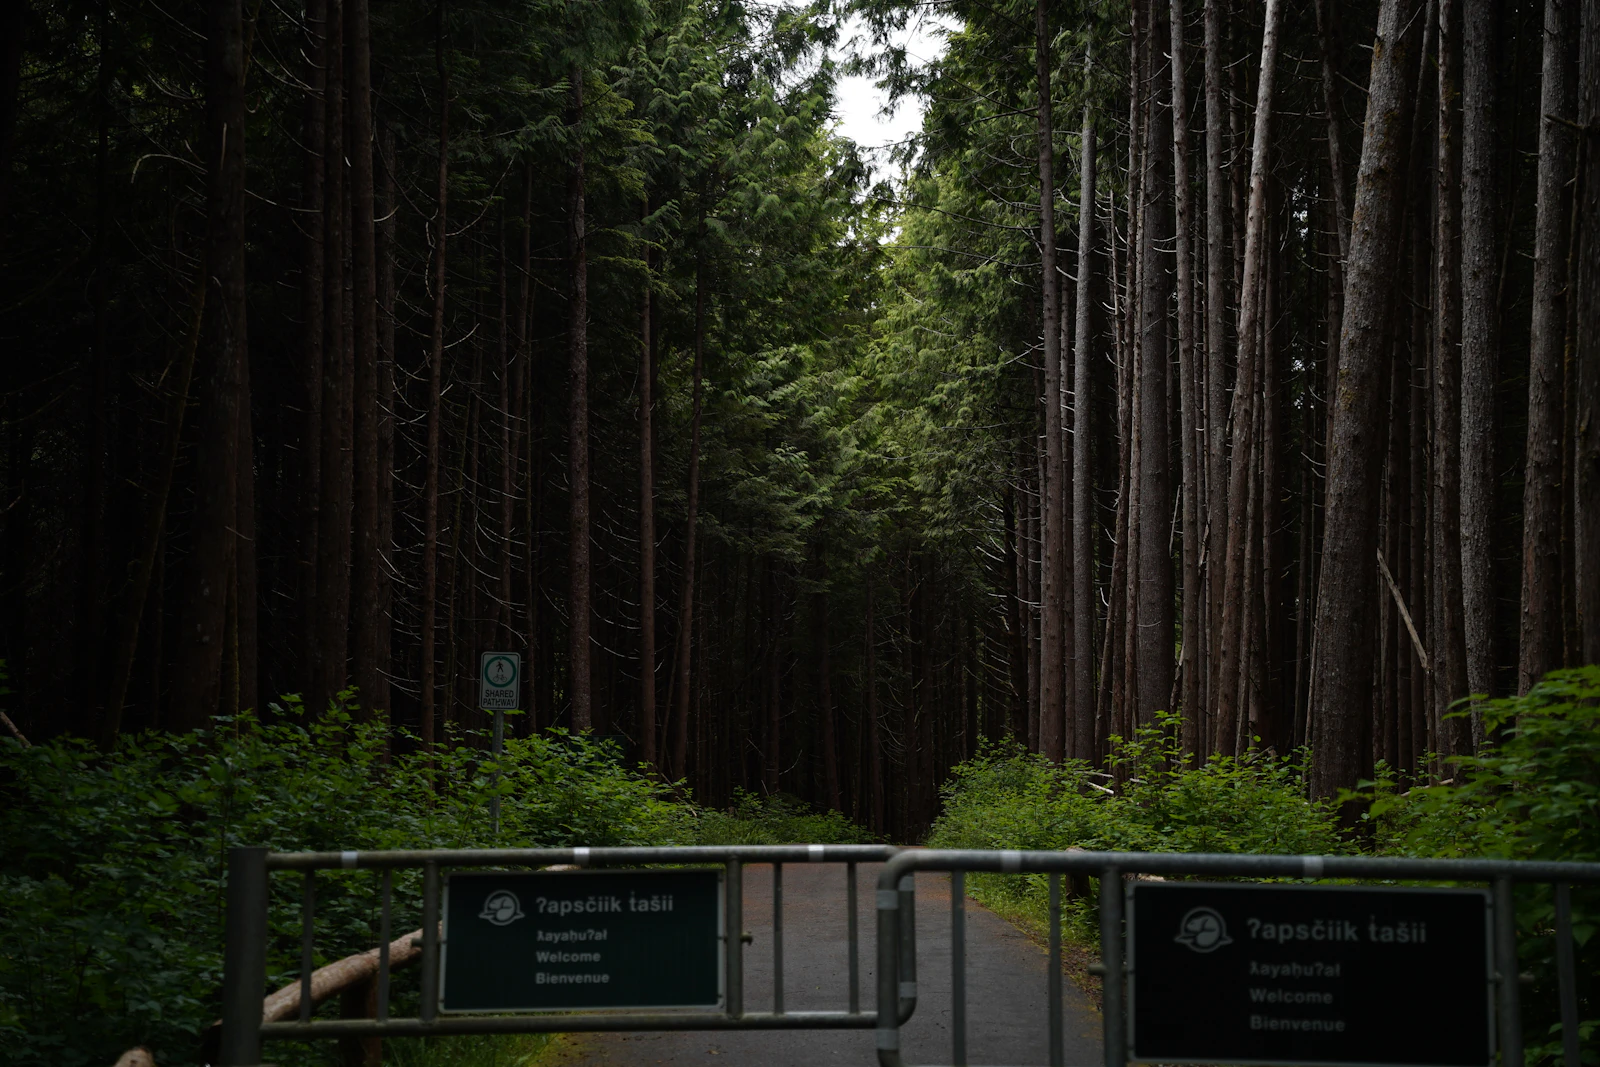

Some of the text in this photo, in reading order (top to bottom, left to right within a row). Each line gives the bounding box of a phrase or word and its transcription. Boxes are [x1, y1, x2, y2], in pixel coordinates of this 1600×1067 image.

[485, 689, 514, 698] SHARED
[483, 698, 516, 706] PATHWAY
[535, 951, 601, 963] Welcome
[535, 972, 610, 985] Bienvenue
[1249, 988, 1334, 1005] Welcome
[1249, 1014, 1347, 1032] Bienvenue
